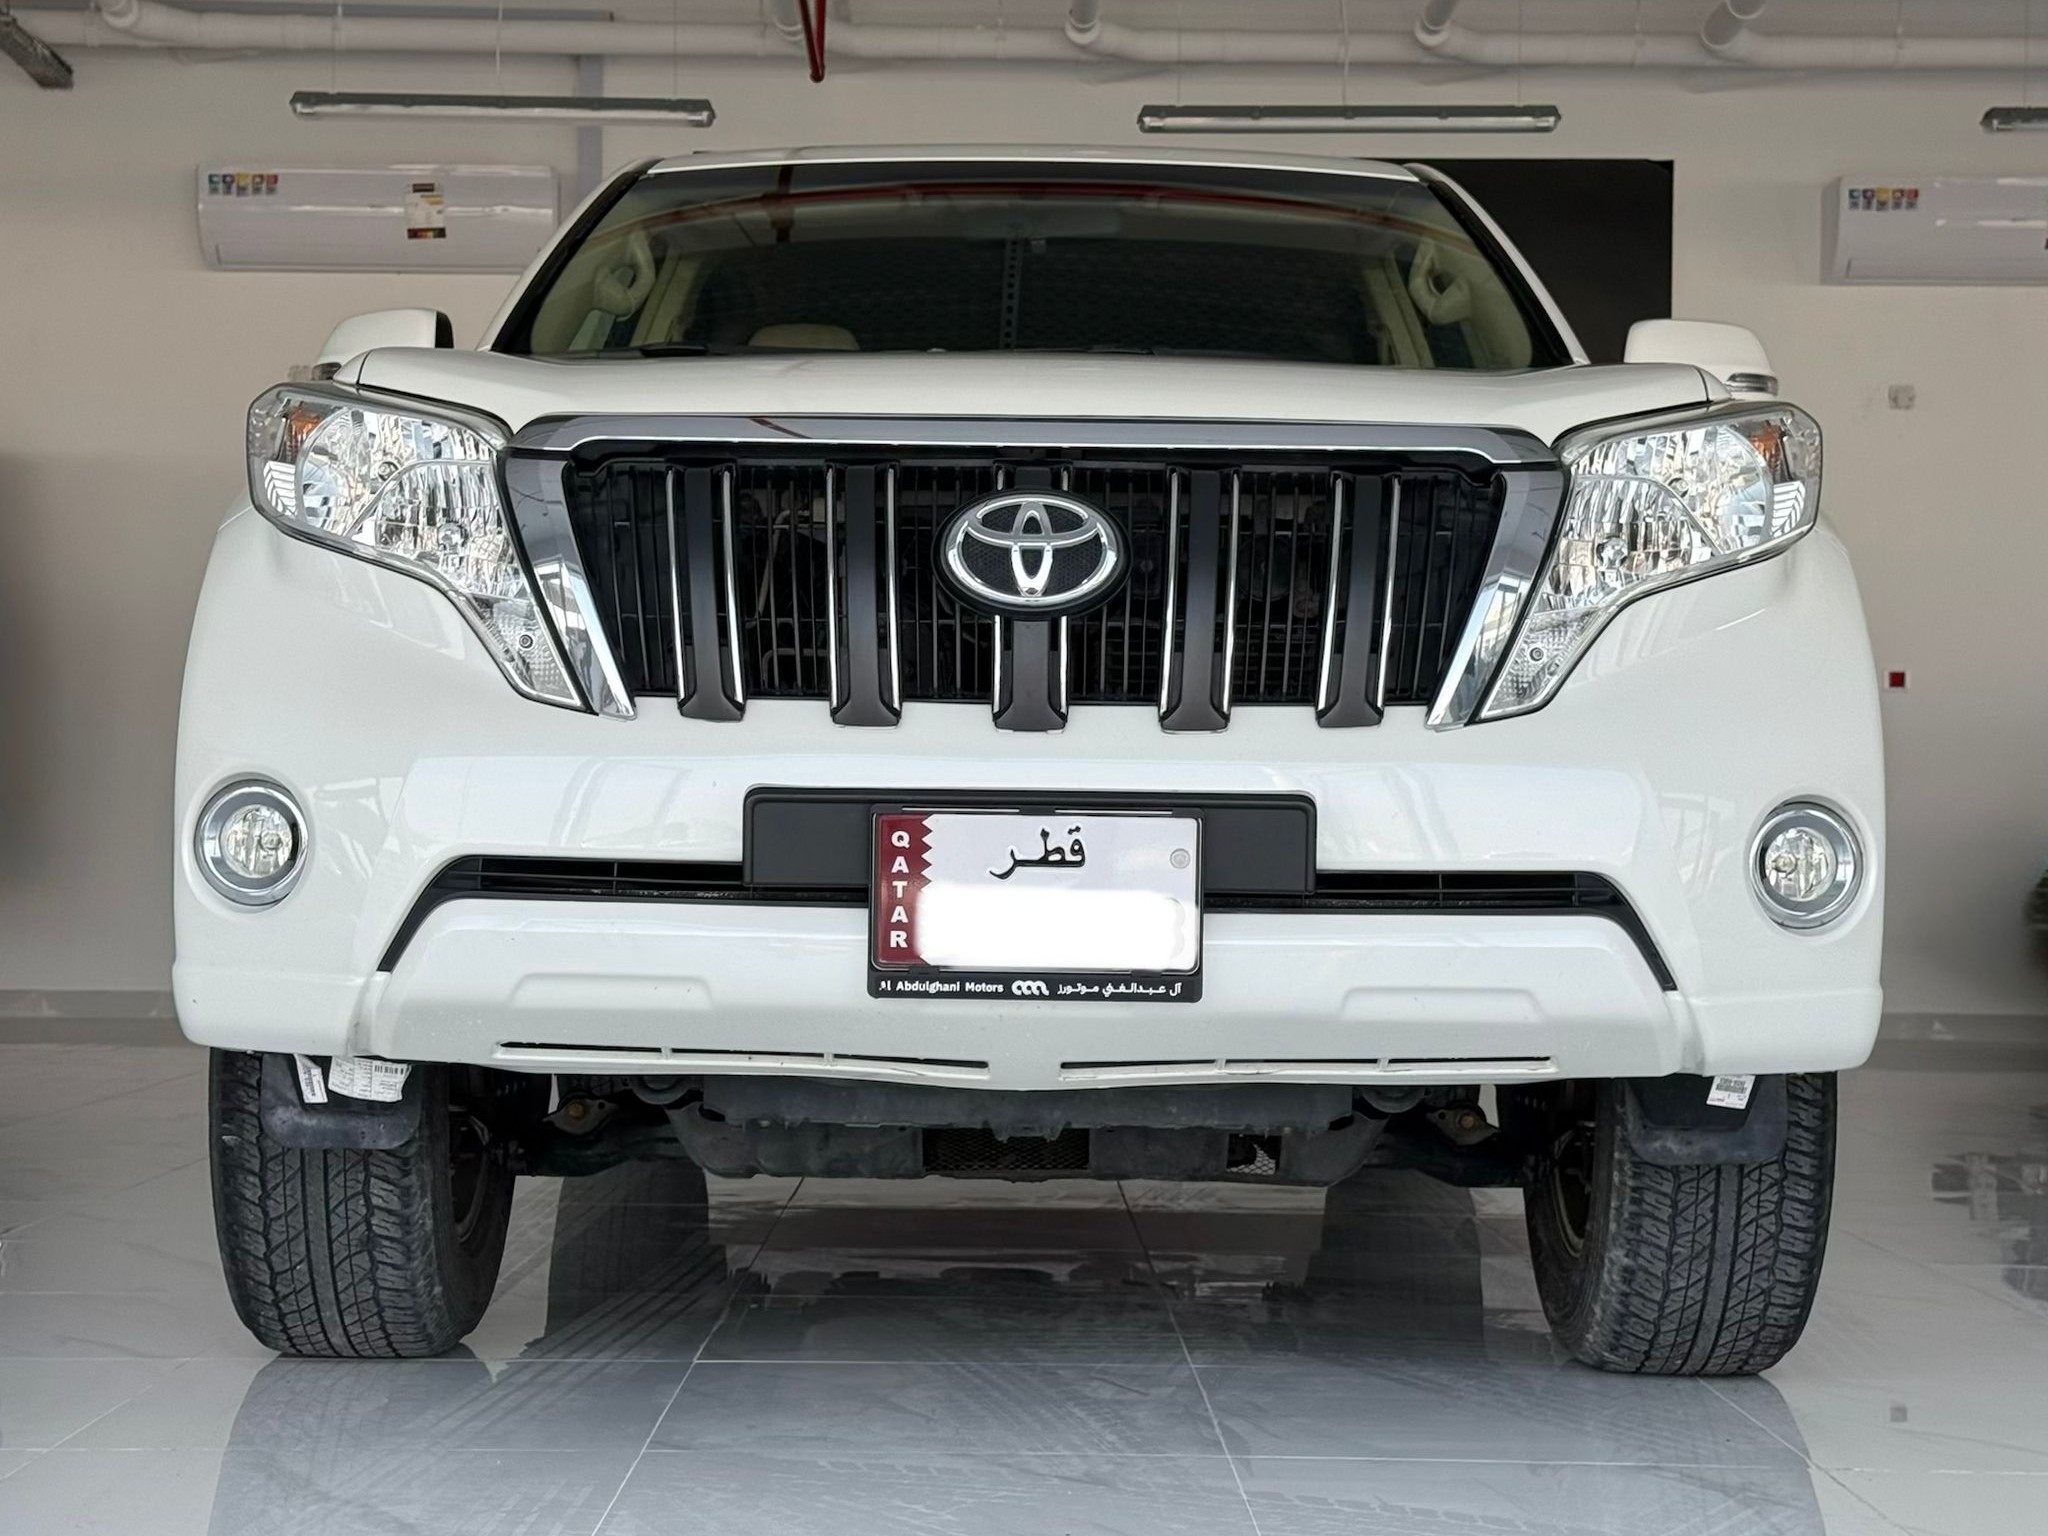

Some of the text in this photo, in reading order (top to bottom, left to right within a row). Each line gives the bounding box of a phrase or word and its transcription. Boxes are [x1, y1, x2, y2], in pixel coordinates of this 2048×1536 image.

[988, 826, 1086, 880] قطر
[889, 830, 911, 949] QATAR
[896, 981, 960, 994] Abdulghani
[965, 981, 1004, 992] Motors
[1057, 982, 1099, 995] موتورز
[1169, 982, 1182, 996] آل
